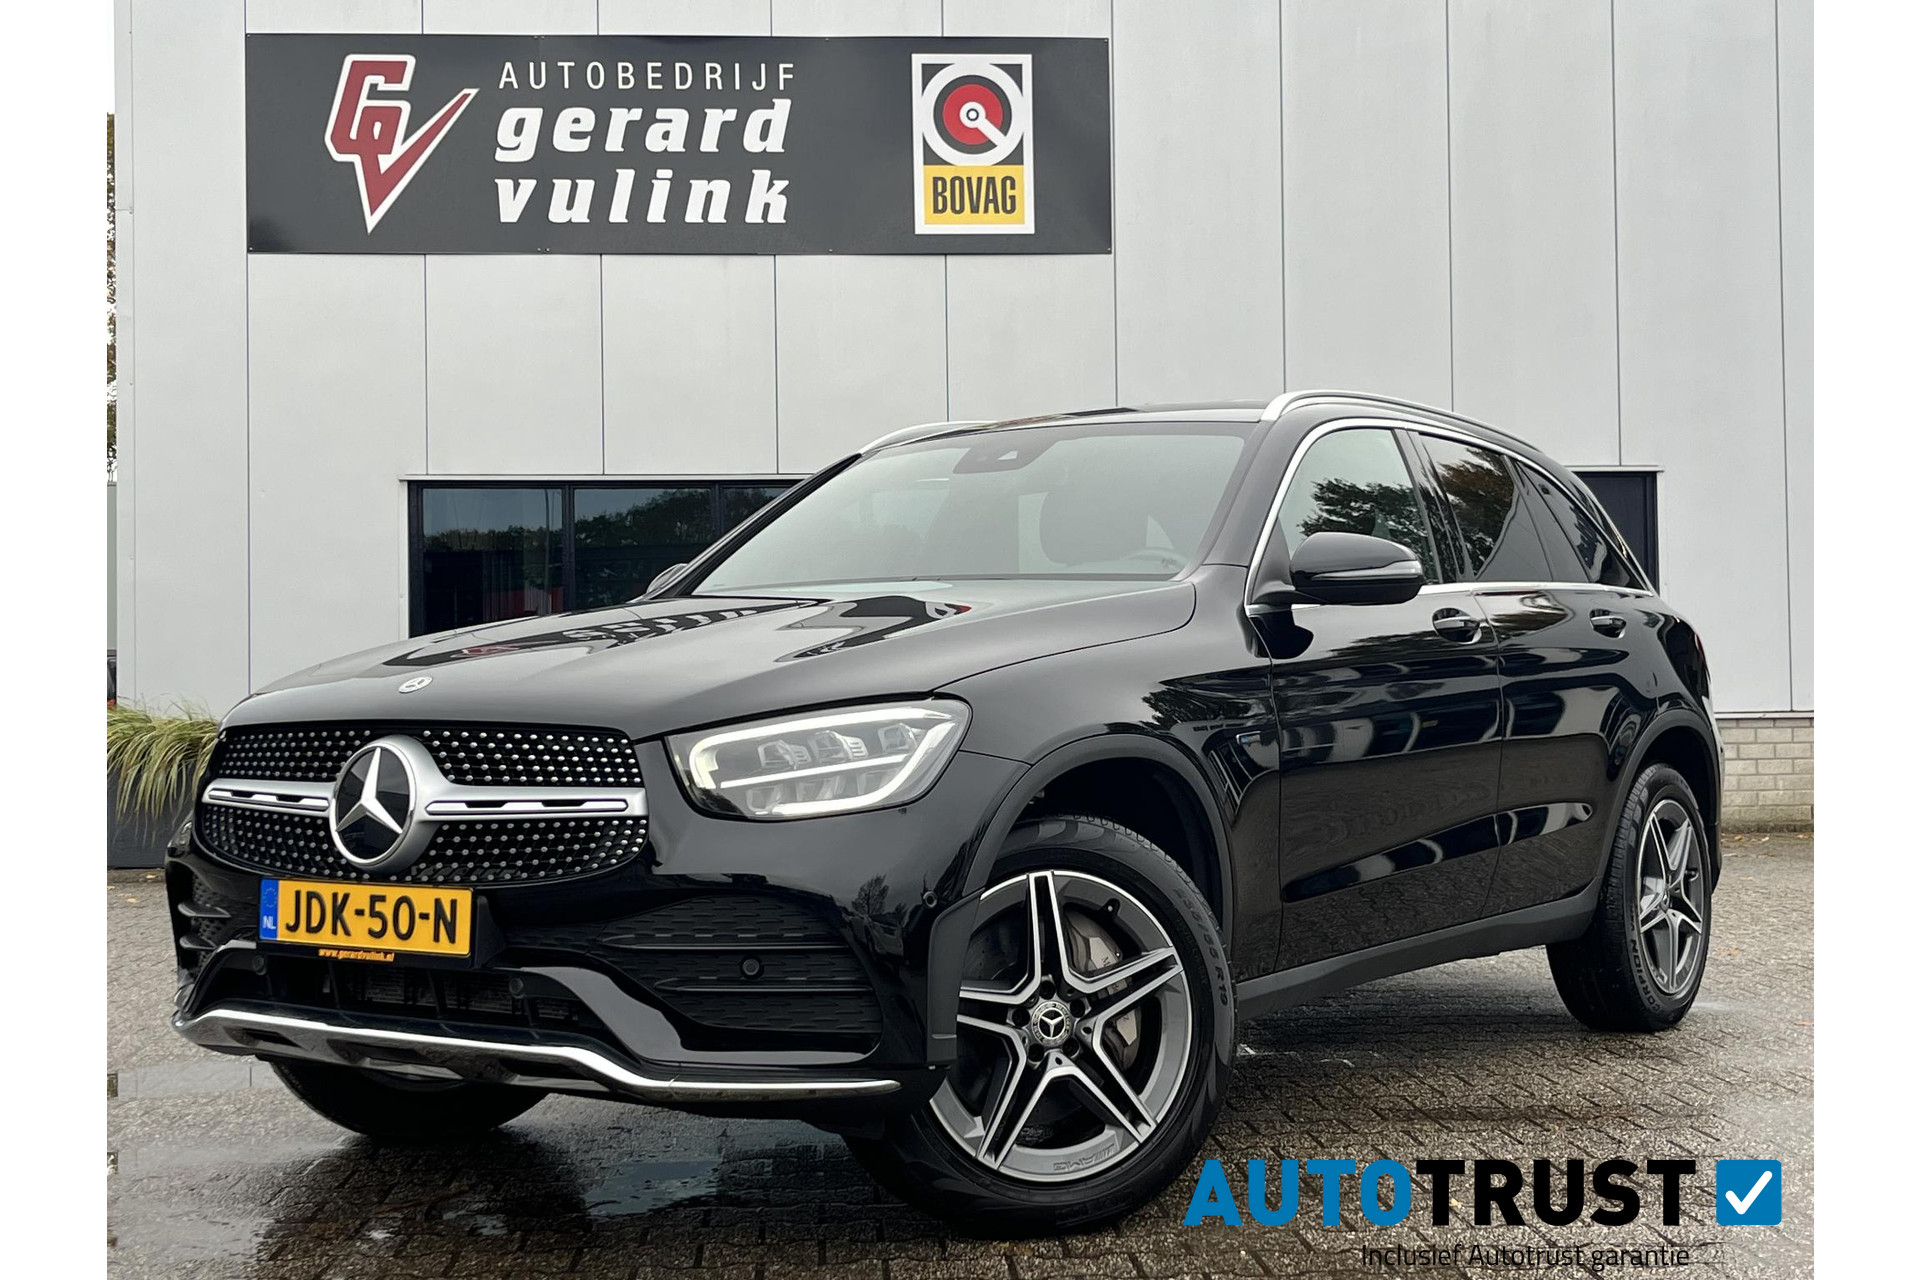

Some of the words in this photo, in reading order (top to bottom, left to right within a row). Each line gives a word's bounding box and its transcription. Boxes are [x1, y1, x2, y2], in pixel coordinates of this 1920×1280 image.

[499, 61, 796, 92] AUTOBEDRIJF
[494, 97, 792, 162] gerard
[494, 168, 790, 224] vulink
[932, 175, 1017, 215] BOVAG
[262, 915, 277, 930] NL
[285, 889, 458, 944] JDK-50-N
[318, 948, 395, 963] www.gerardvulink.nl
[1630, 938, 1661, 1012] CORPION
